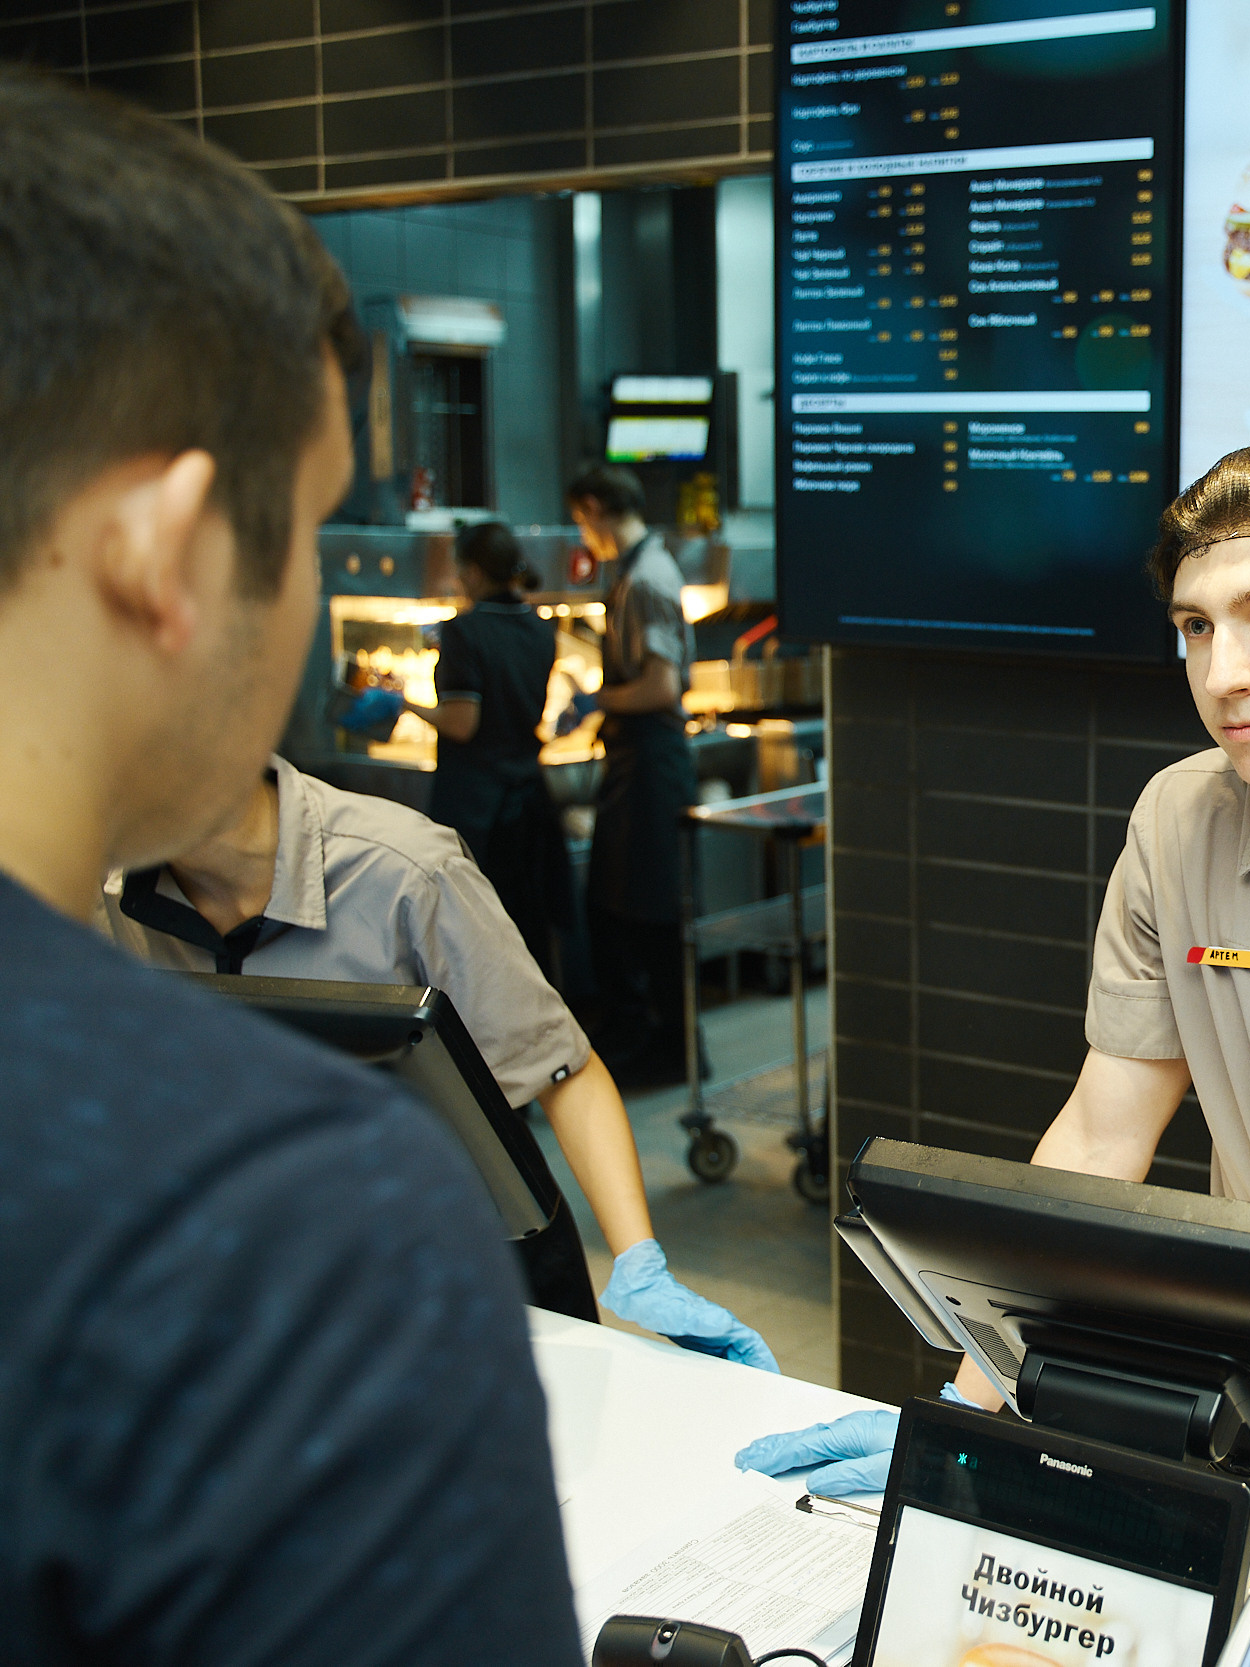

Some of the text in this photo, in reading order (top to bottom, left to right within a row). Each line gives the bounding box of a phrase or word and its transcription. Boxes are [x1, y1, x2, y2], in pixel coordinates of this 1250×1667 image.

[1209, 949, 1239, 961] АРТЕМ
[1039, 1452, 1094, 1478] Panasonic
[973, 1552, 1105, 1615] Двойной
[961, 1583, 1115, 1658] Чизбургер
